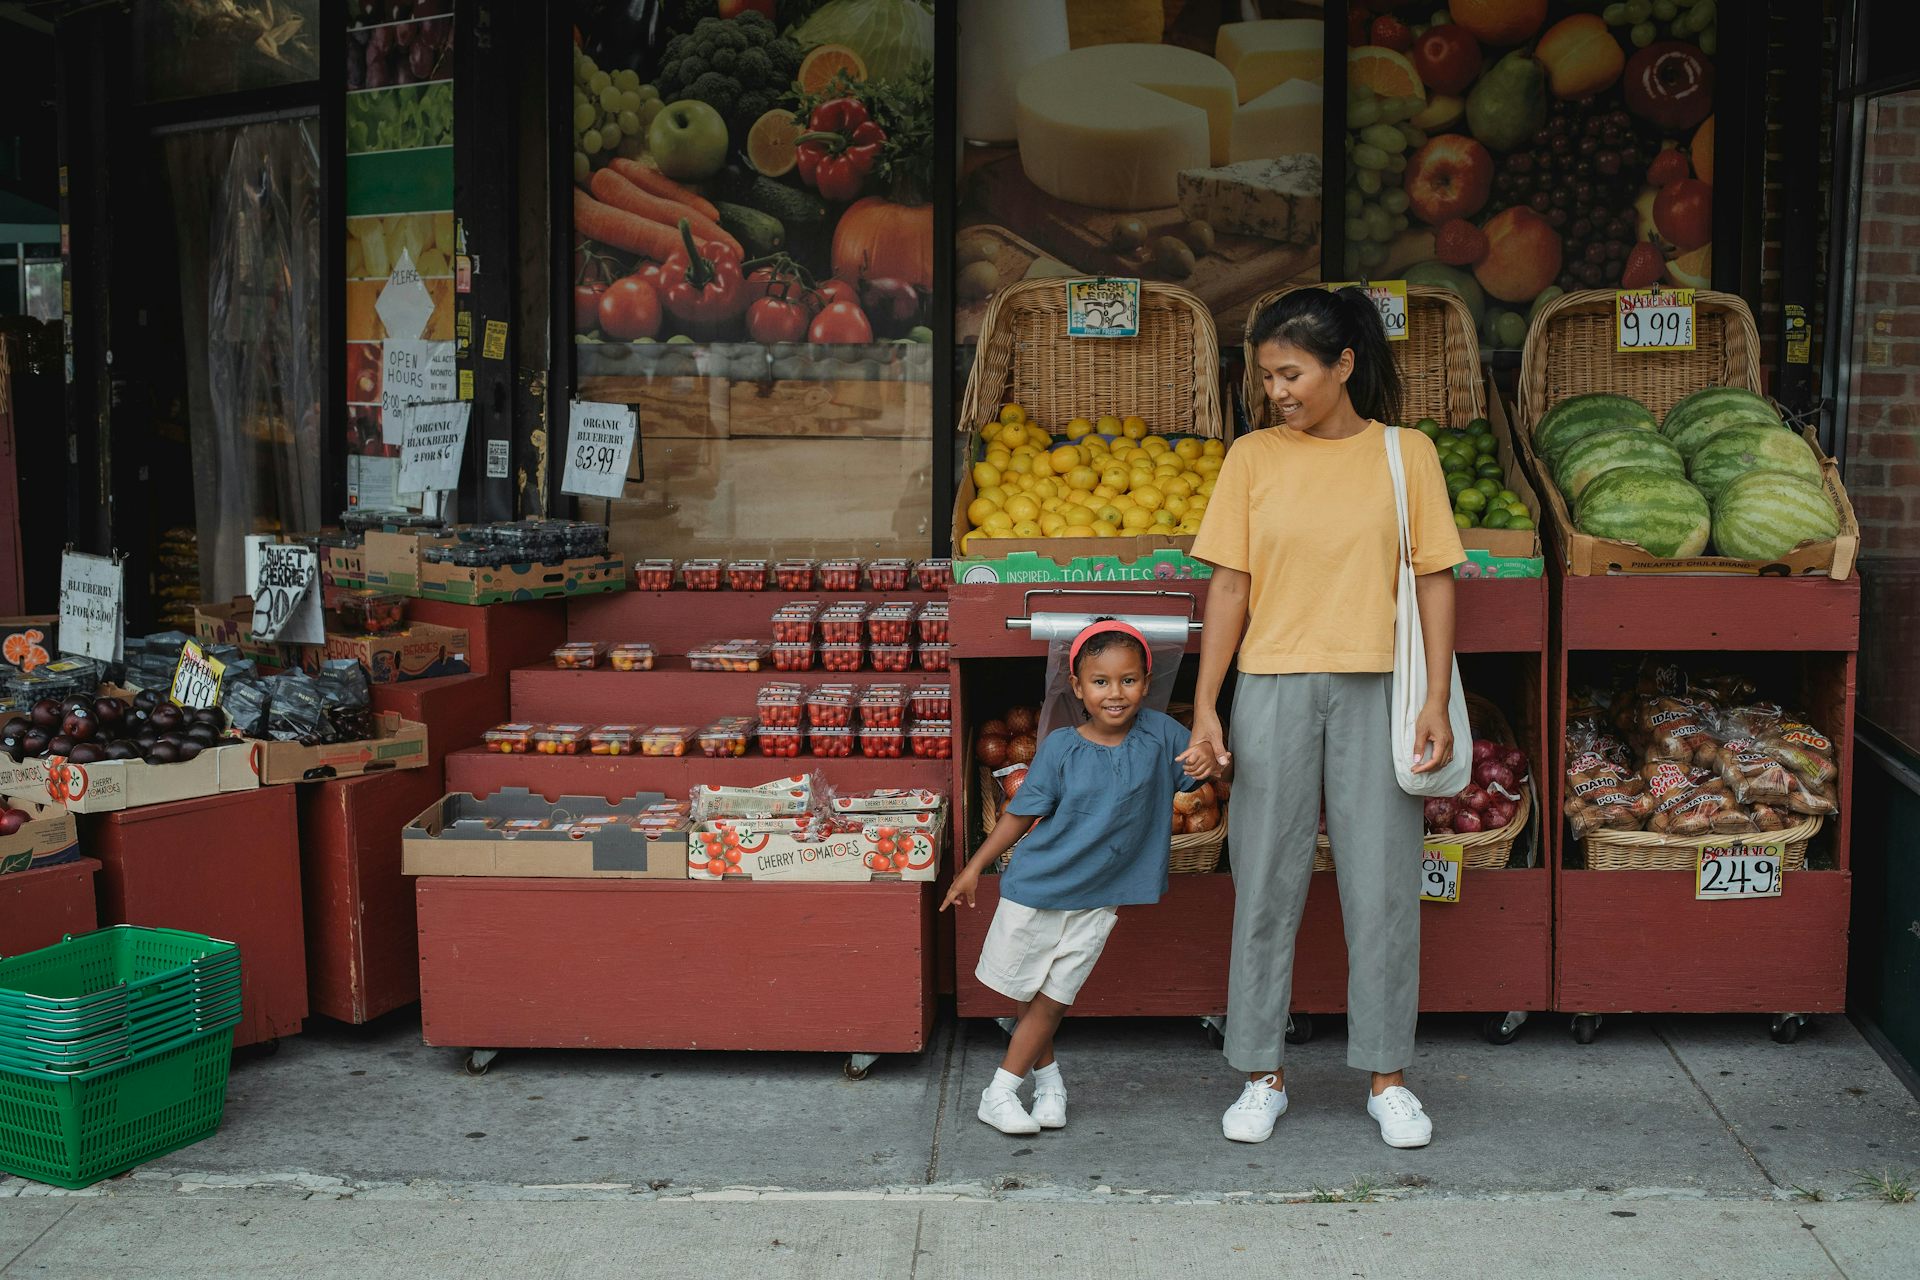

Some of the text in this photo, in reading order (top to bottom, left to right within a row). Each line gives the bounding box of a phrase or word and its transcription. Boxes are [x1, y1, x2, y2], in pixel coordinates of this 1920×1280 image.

[392, 269, 419, 285] PLEASE
[1077, 282, 1125, 292] FRESH
[1077, 291, 1124, 301] LEMON
[1623, 312, 1680, 347] 9.99
[390, 351, 418, 369] OPEN
[387, 368, 423, 388] HOURS
[416, 421, 452, 433] ORGANIC
[583, 418, 621, 430] ORGANIC
[407, 434, 459, 448] BLACKBERRY
[577, 432, 624, 445] BLUEBERRY
[413, 453, 419, 462] 2
[420, 451, 436, 462] FOR
[575, 445, 615, 474] $3.99
[266, 547, 308, 568] SWEET
[68, 579, 113, 598] BLUEBERRY
[66, 604, 71, 615] 2
[72, 605, 89, 619] FOR
[403, 642, 438, 656] BERRIES
[1659, 764, 1678, 773] the
[87, 783, 120, 798] TOMATOES
[92, 778, 112, 788] CHERRY
[1575, 777, 1616, 796] IDAHO
[881, 798, 908, 807] TOMATOES
[757, 839, 861, 871] CHERRY TOMATOES
[1702, 845, 1778, 860] POTATO
[1701, 860, 1781, 893] 2.49 BAG
[1446, 880, 1456, 901] BAG
